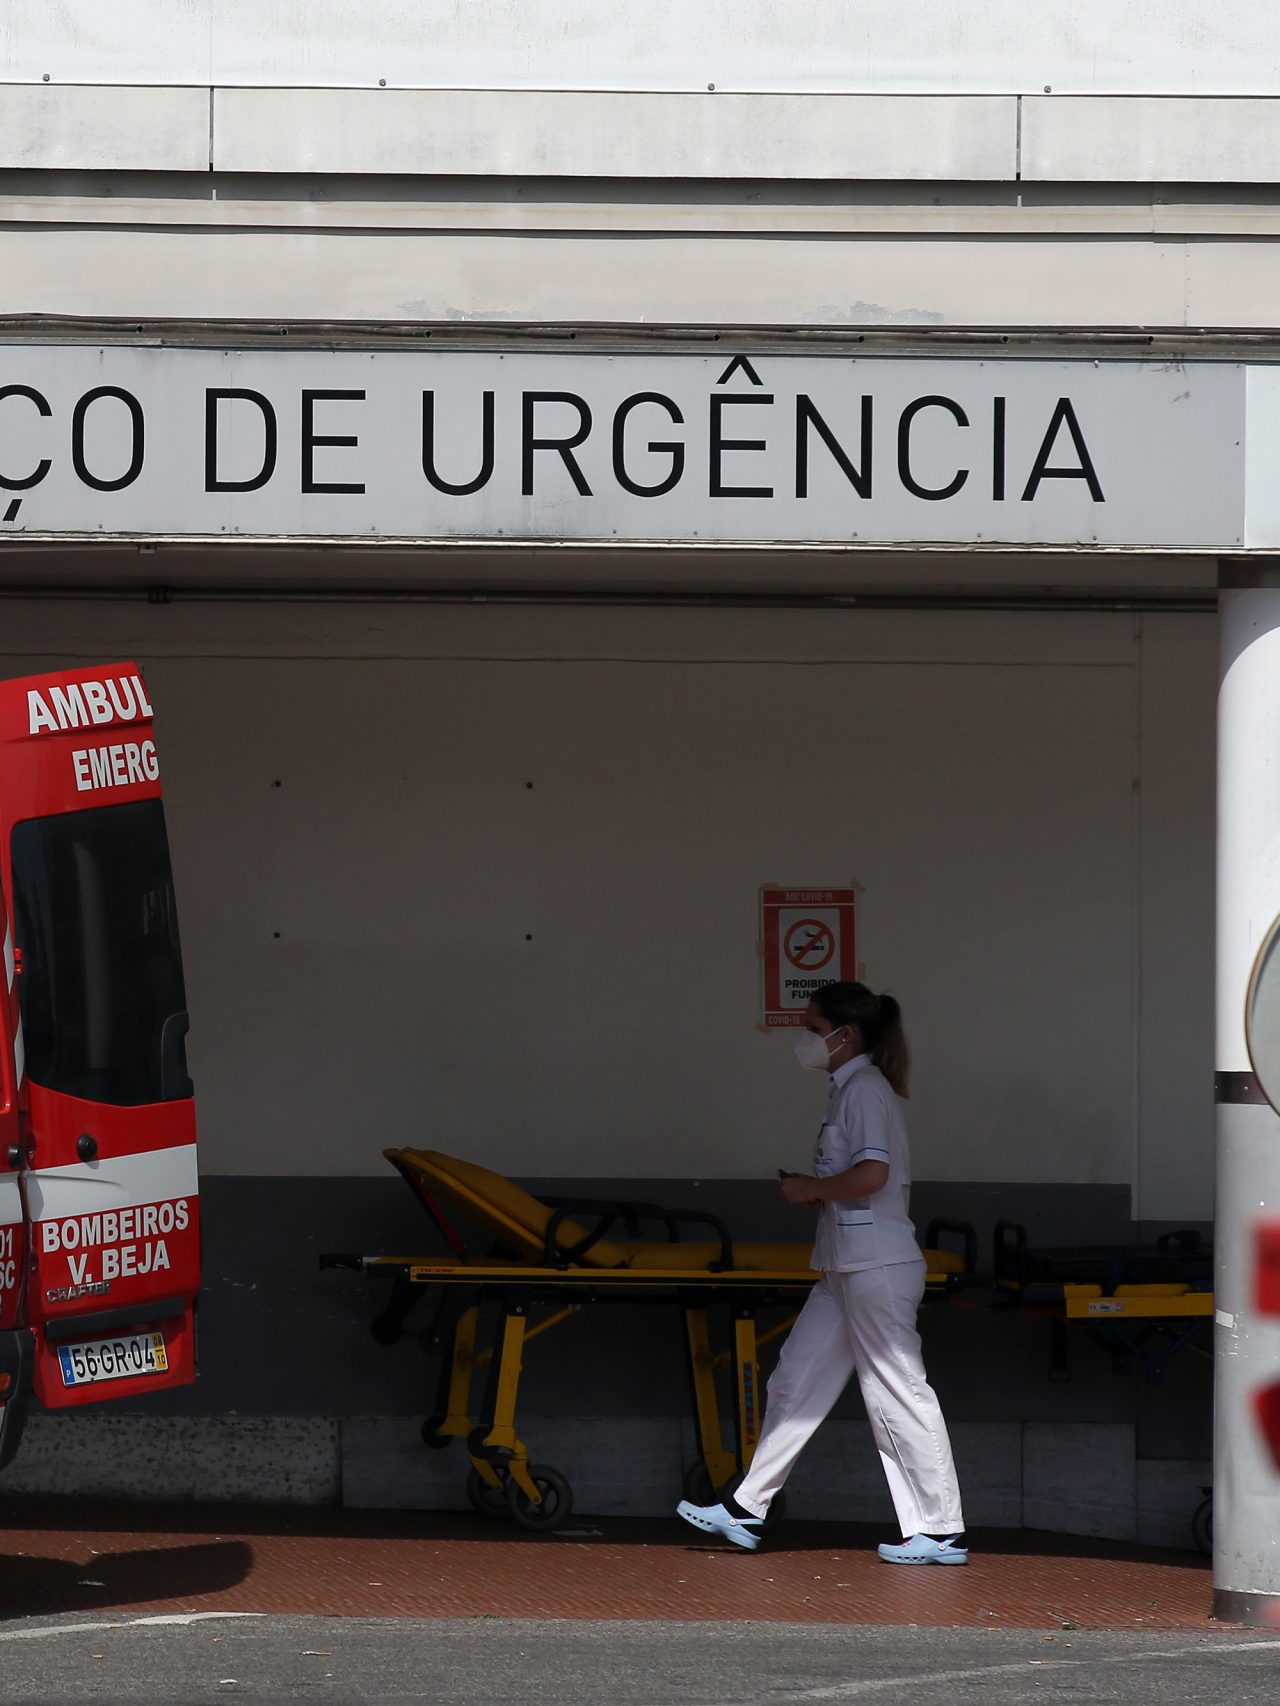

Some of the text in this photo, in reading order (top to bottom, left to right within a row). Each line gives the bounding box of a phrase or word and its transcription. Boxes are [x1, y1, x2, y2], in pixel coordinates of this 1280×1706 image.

[204, 386, 367, 495] DE
[421, 354, 1107, 503] URGÊNCIA
[26, 675, 154, 735] AMBUL
[72, 739, 160, 792] EMERG
[768, 1015, 800, 1025] COVID-19
[42, 1199, 189, 1253] BOMBEIROS
[67, 1239, 170, 1286] V. BEJA
[46, 1281, 111, 1303] CRAFTER
